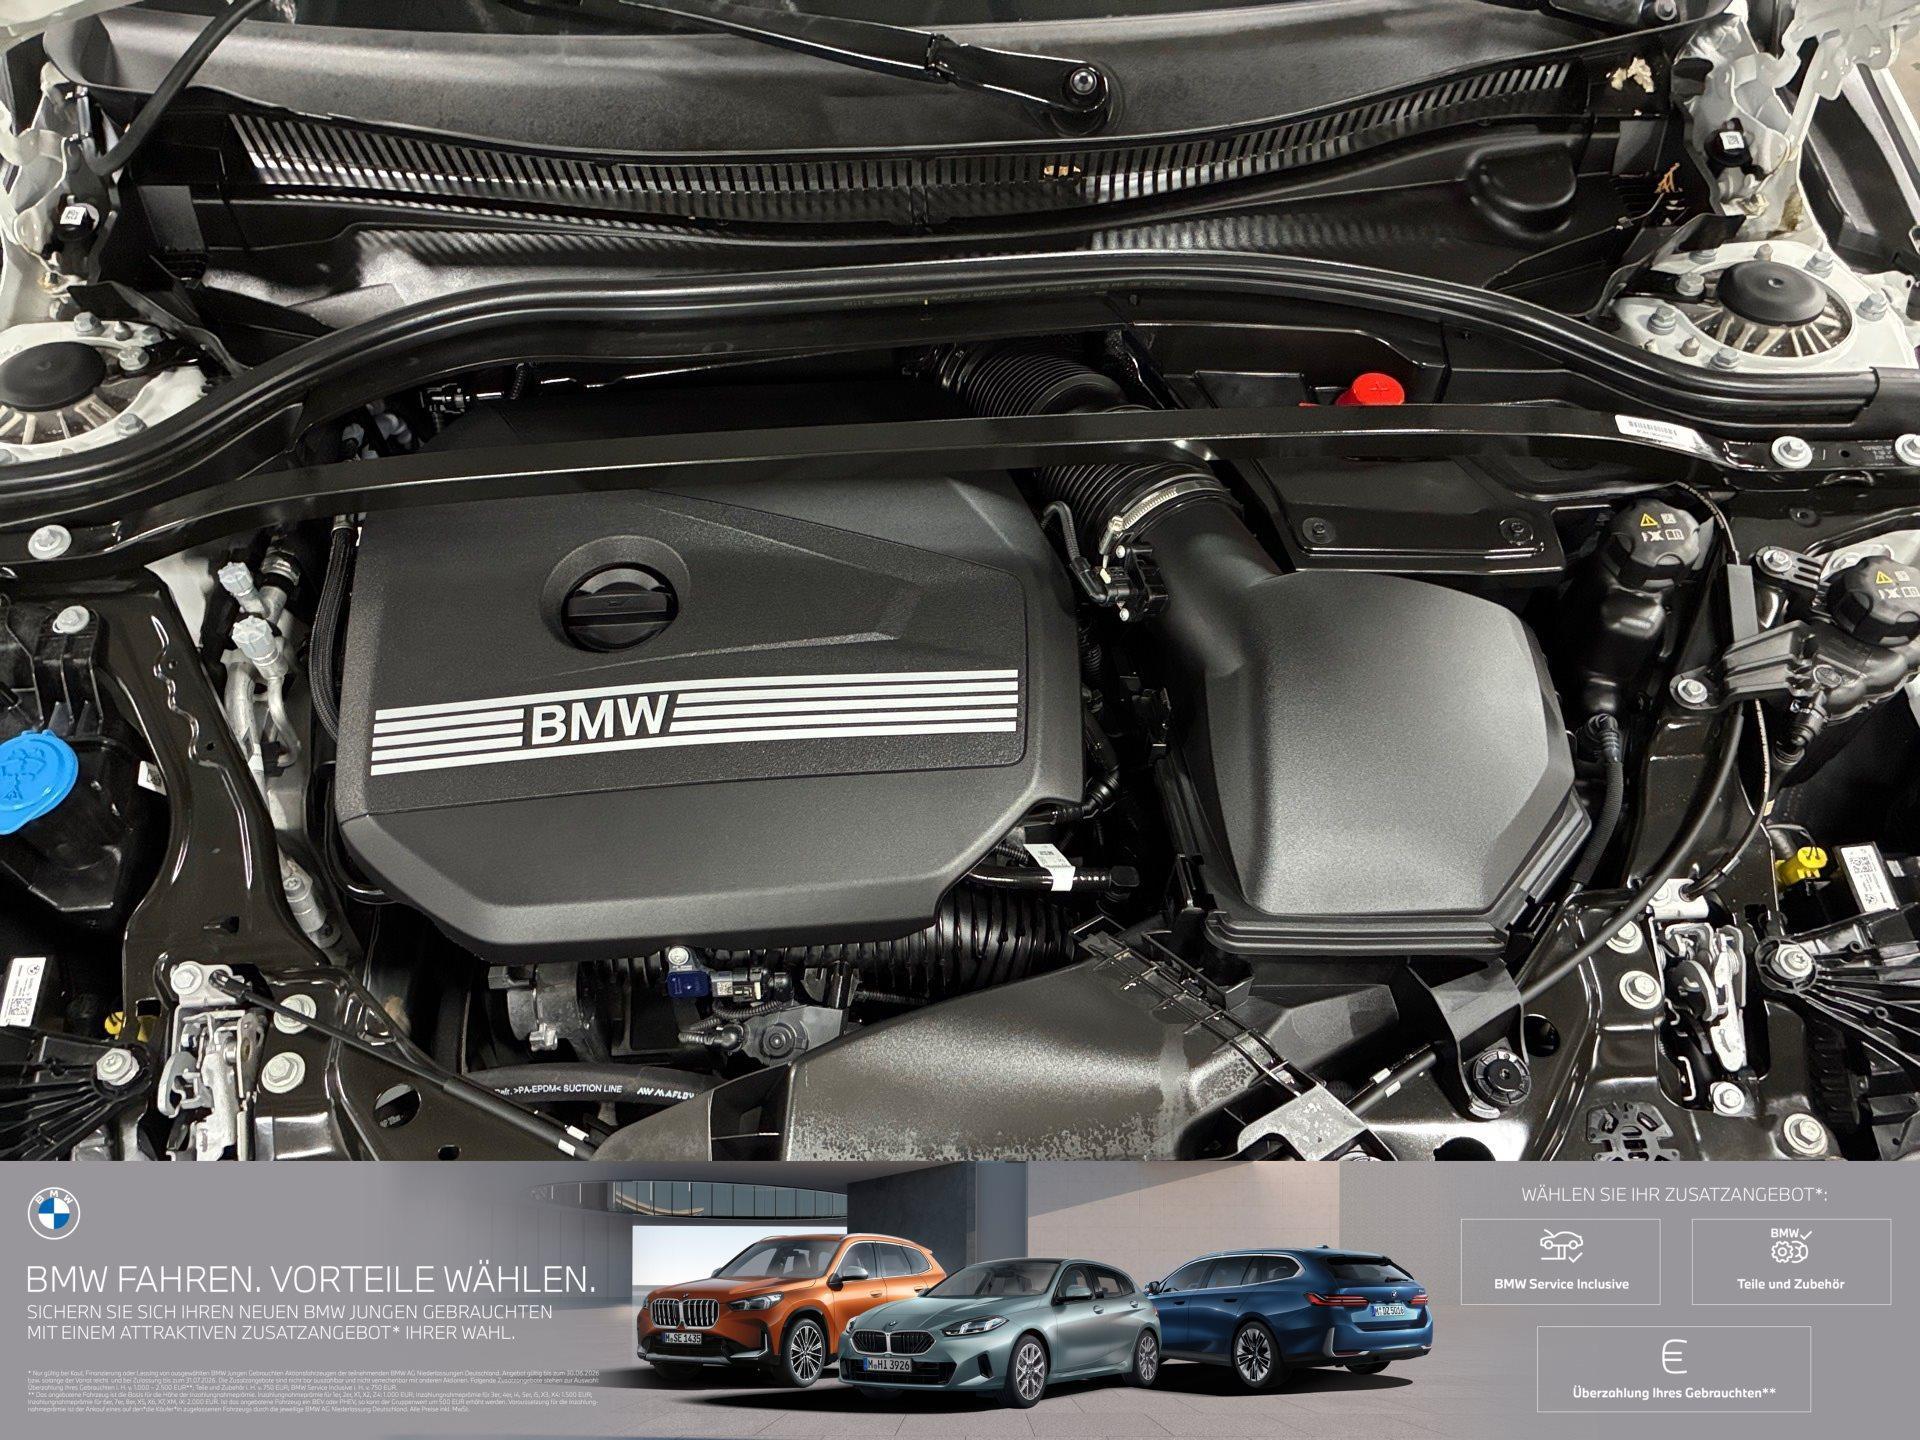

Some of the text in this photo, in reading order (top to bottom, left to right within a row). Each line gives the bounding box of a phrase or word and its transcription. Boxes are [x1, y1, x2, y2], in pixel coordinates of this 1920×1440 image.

[532, 694, 669, 745] BMW
[563, 1084, 602, 1093] SUCTION
[603, 1084, 623, 1094] LINE
[889, 1360, 910, 1371] 3926
